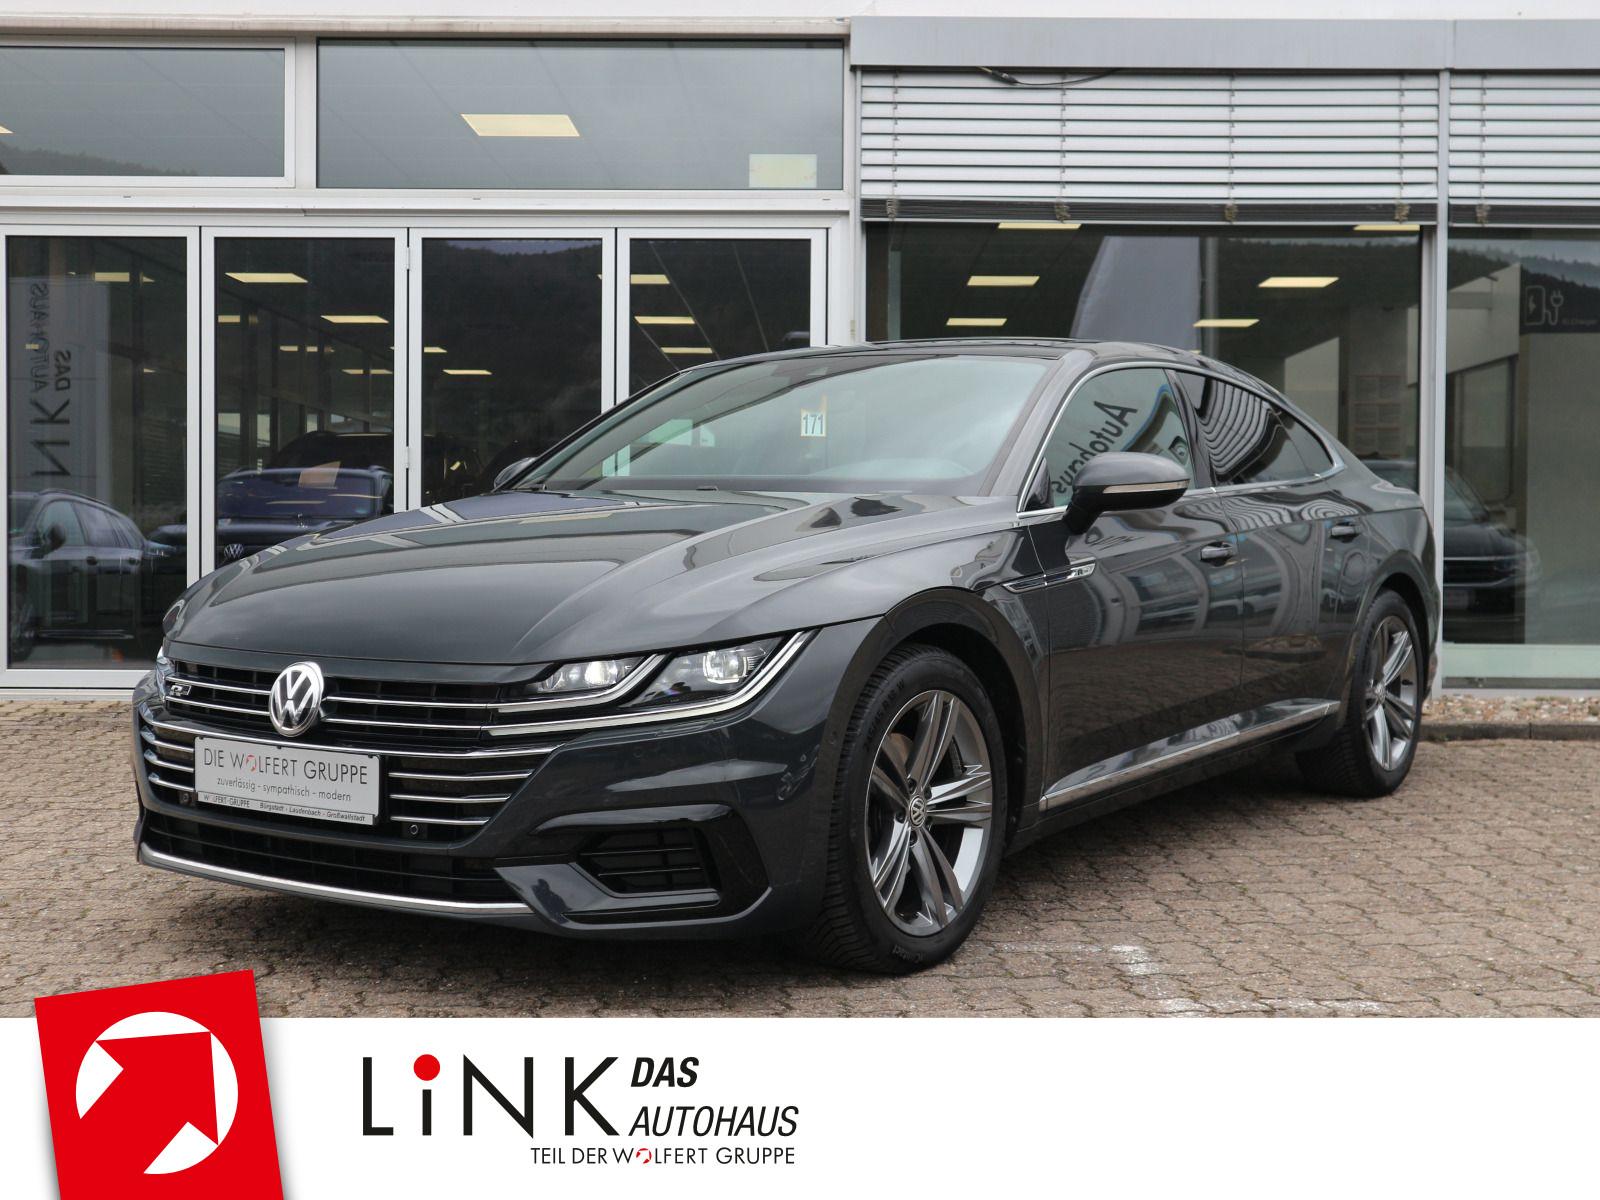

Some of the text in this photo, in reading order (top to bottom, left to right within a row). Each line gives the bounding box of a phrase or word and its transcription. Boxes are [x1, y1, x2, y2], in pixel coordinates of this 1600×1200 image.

[802, 413, 824, 435] 171
[271, 663, 321, 735] VW
[203, 748, 224, 768] DIE
[303, 760, 368, 785] GRUPPE
[217, 777, 256, 792] zuverlässig
[263, 782, 310, 798] sympathisch
[318, 790, 351, 801] modern
